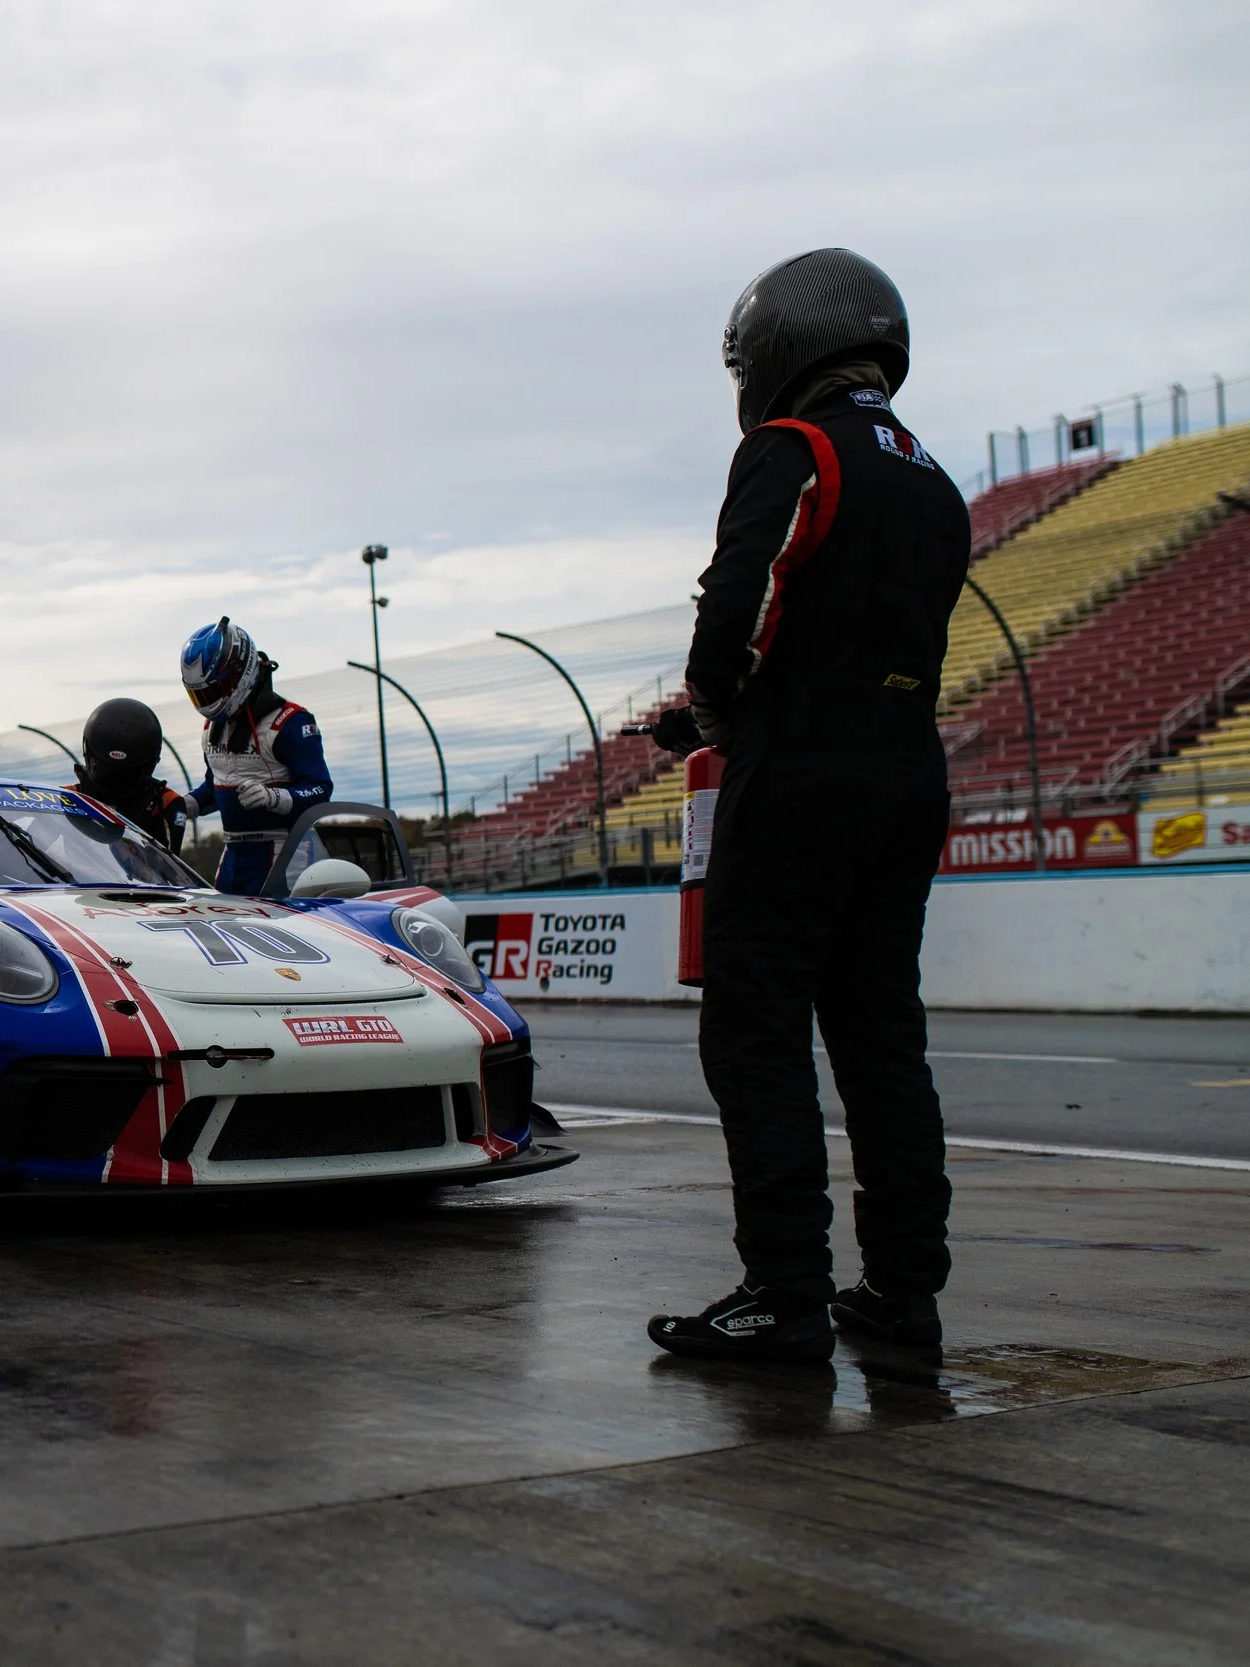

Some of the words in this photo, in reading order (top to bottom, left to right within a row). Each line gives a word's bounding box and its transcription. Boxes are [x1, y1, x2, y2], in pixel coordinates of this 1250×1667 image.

[880, 444, 904, 458] ROUND
[911, 457, 935, 470] RACING
[6, 788, 77, 807] LOVE
[83, 902, 271, 919] Aubrey
[540, 913, 626, 932] TOYOTA
[136, 919, 331, 966] 70
[537, 936, 617, 956] GAZOO
[465, 938, 529, 979] GR
[535, 959, 613, 985] Racing
[291, 1020, 355, 1035] WRL
[355, 1019, 394, 1032] GTO
[299, 1034, 332, 1043] WORLD
[333, 1034, 368, 1042] RACING
[369, 1033, 400, 1041] LEAGUE
[726, 1314, 775, 1329] sparco
